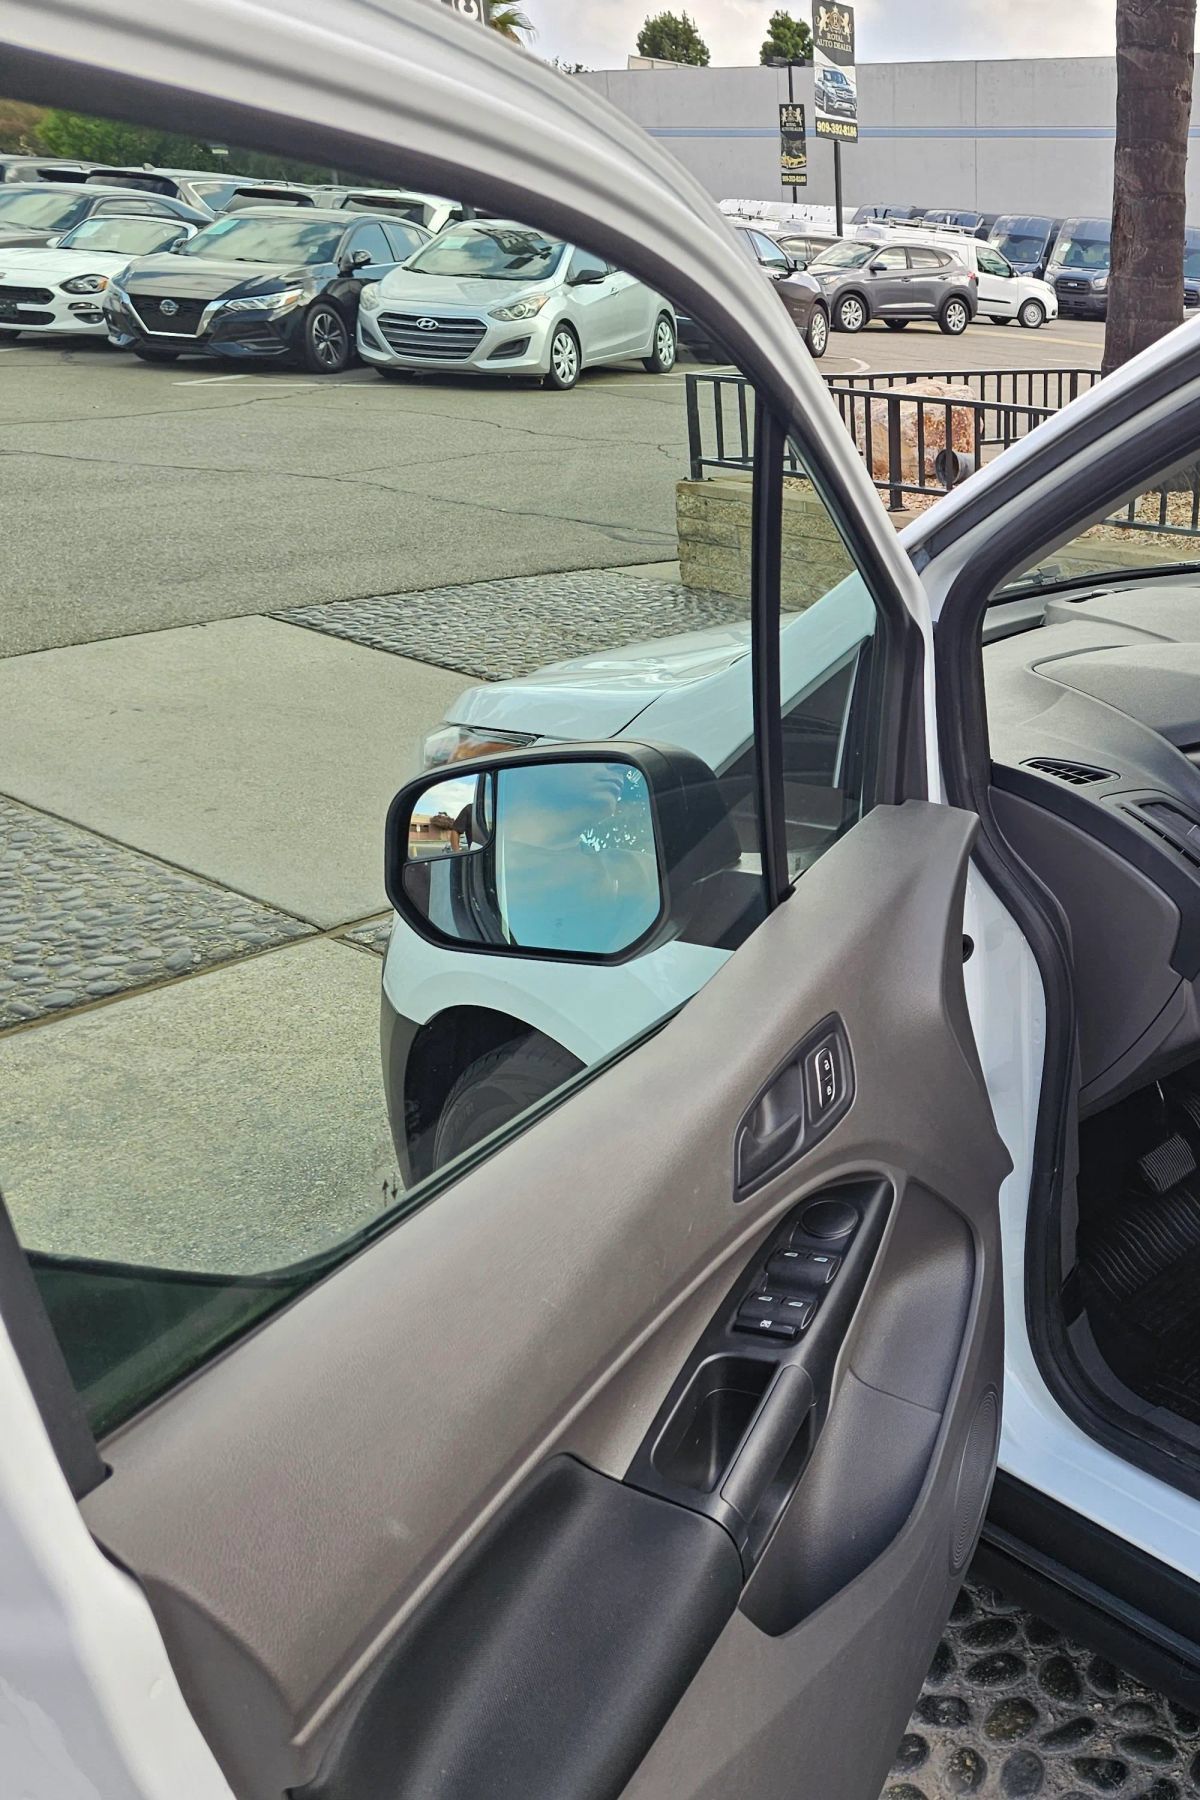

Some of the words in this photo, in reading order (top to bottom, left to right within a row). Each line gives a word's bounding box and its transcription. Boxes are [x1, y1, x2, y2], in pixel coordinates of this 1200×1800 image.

[827, 32, 844, 43] ROYAL
[816, 38, 833, 48] AUTO
[833, 42, 853, 53] DEALER
